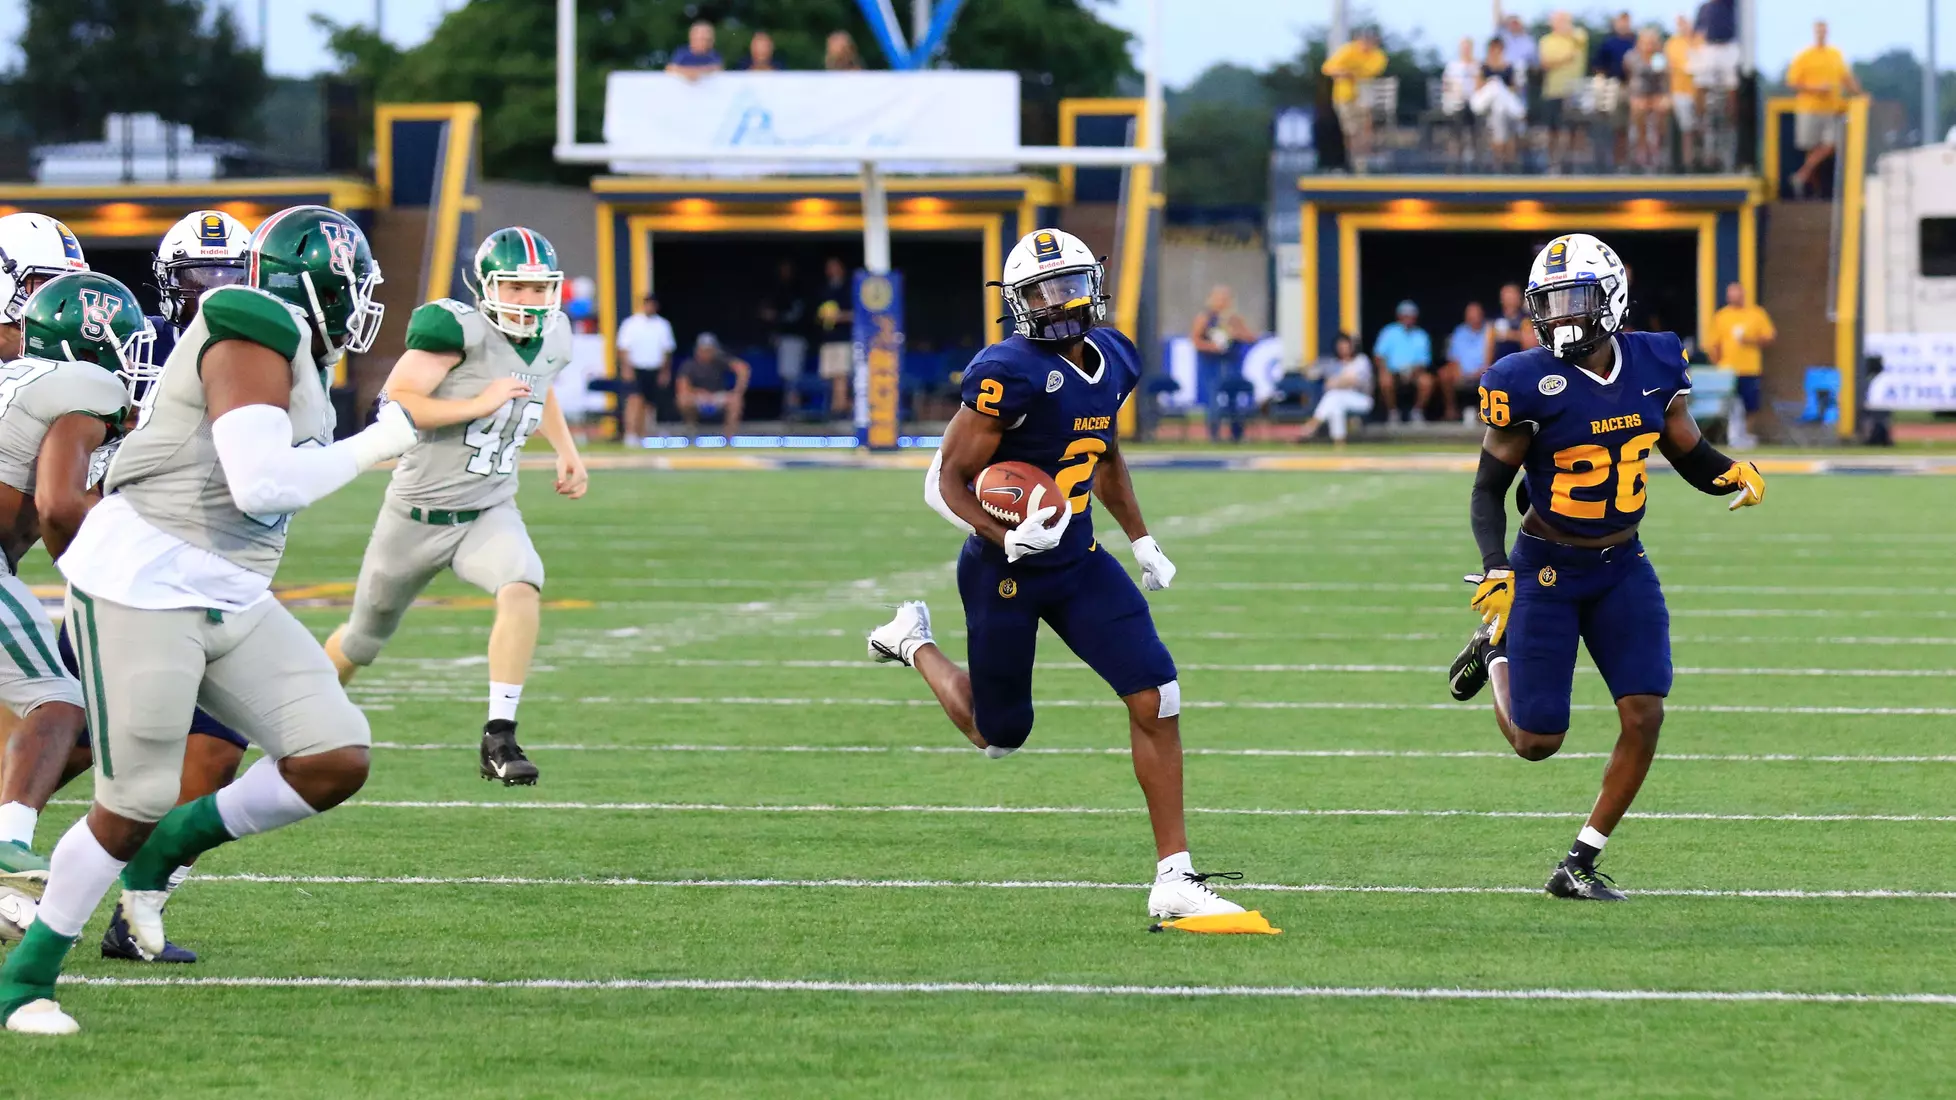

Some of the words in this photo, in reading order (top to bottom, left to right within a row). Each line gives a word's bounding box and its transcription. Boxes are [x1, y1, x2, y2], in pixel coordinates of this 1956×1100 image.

[976, 378, 1004, 416] 2
[1478, 385, 1511, 427] 26
[1073, 415, 1111, 431] RACERS
[1590, 413, 1642, 435] RACERS
[1054, 437, 1107, 515] 2
[1549, 432, 1661, 519] 26
